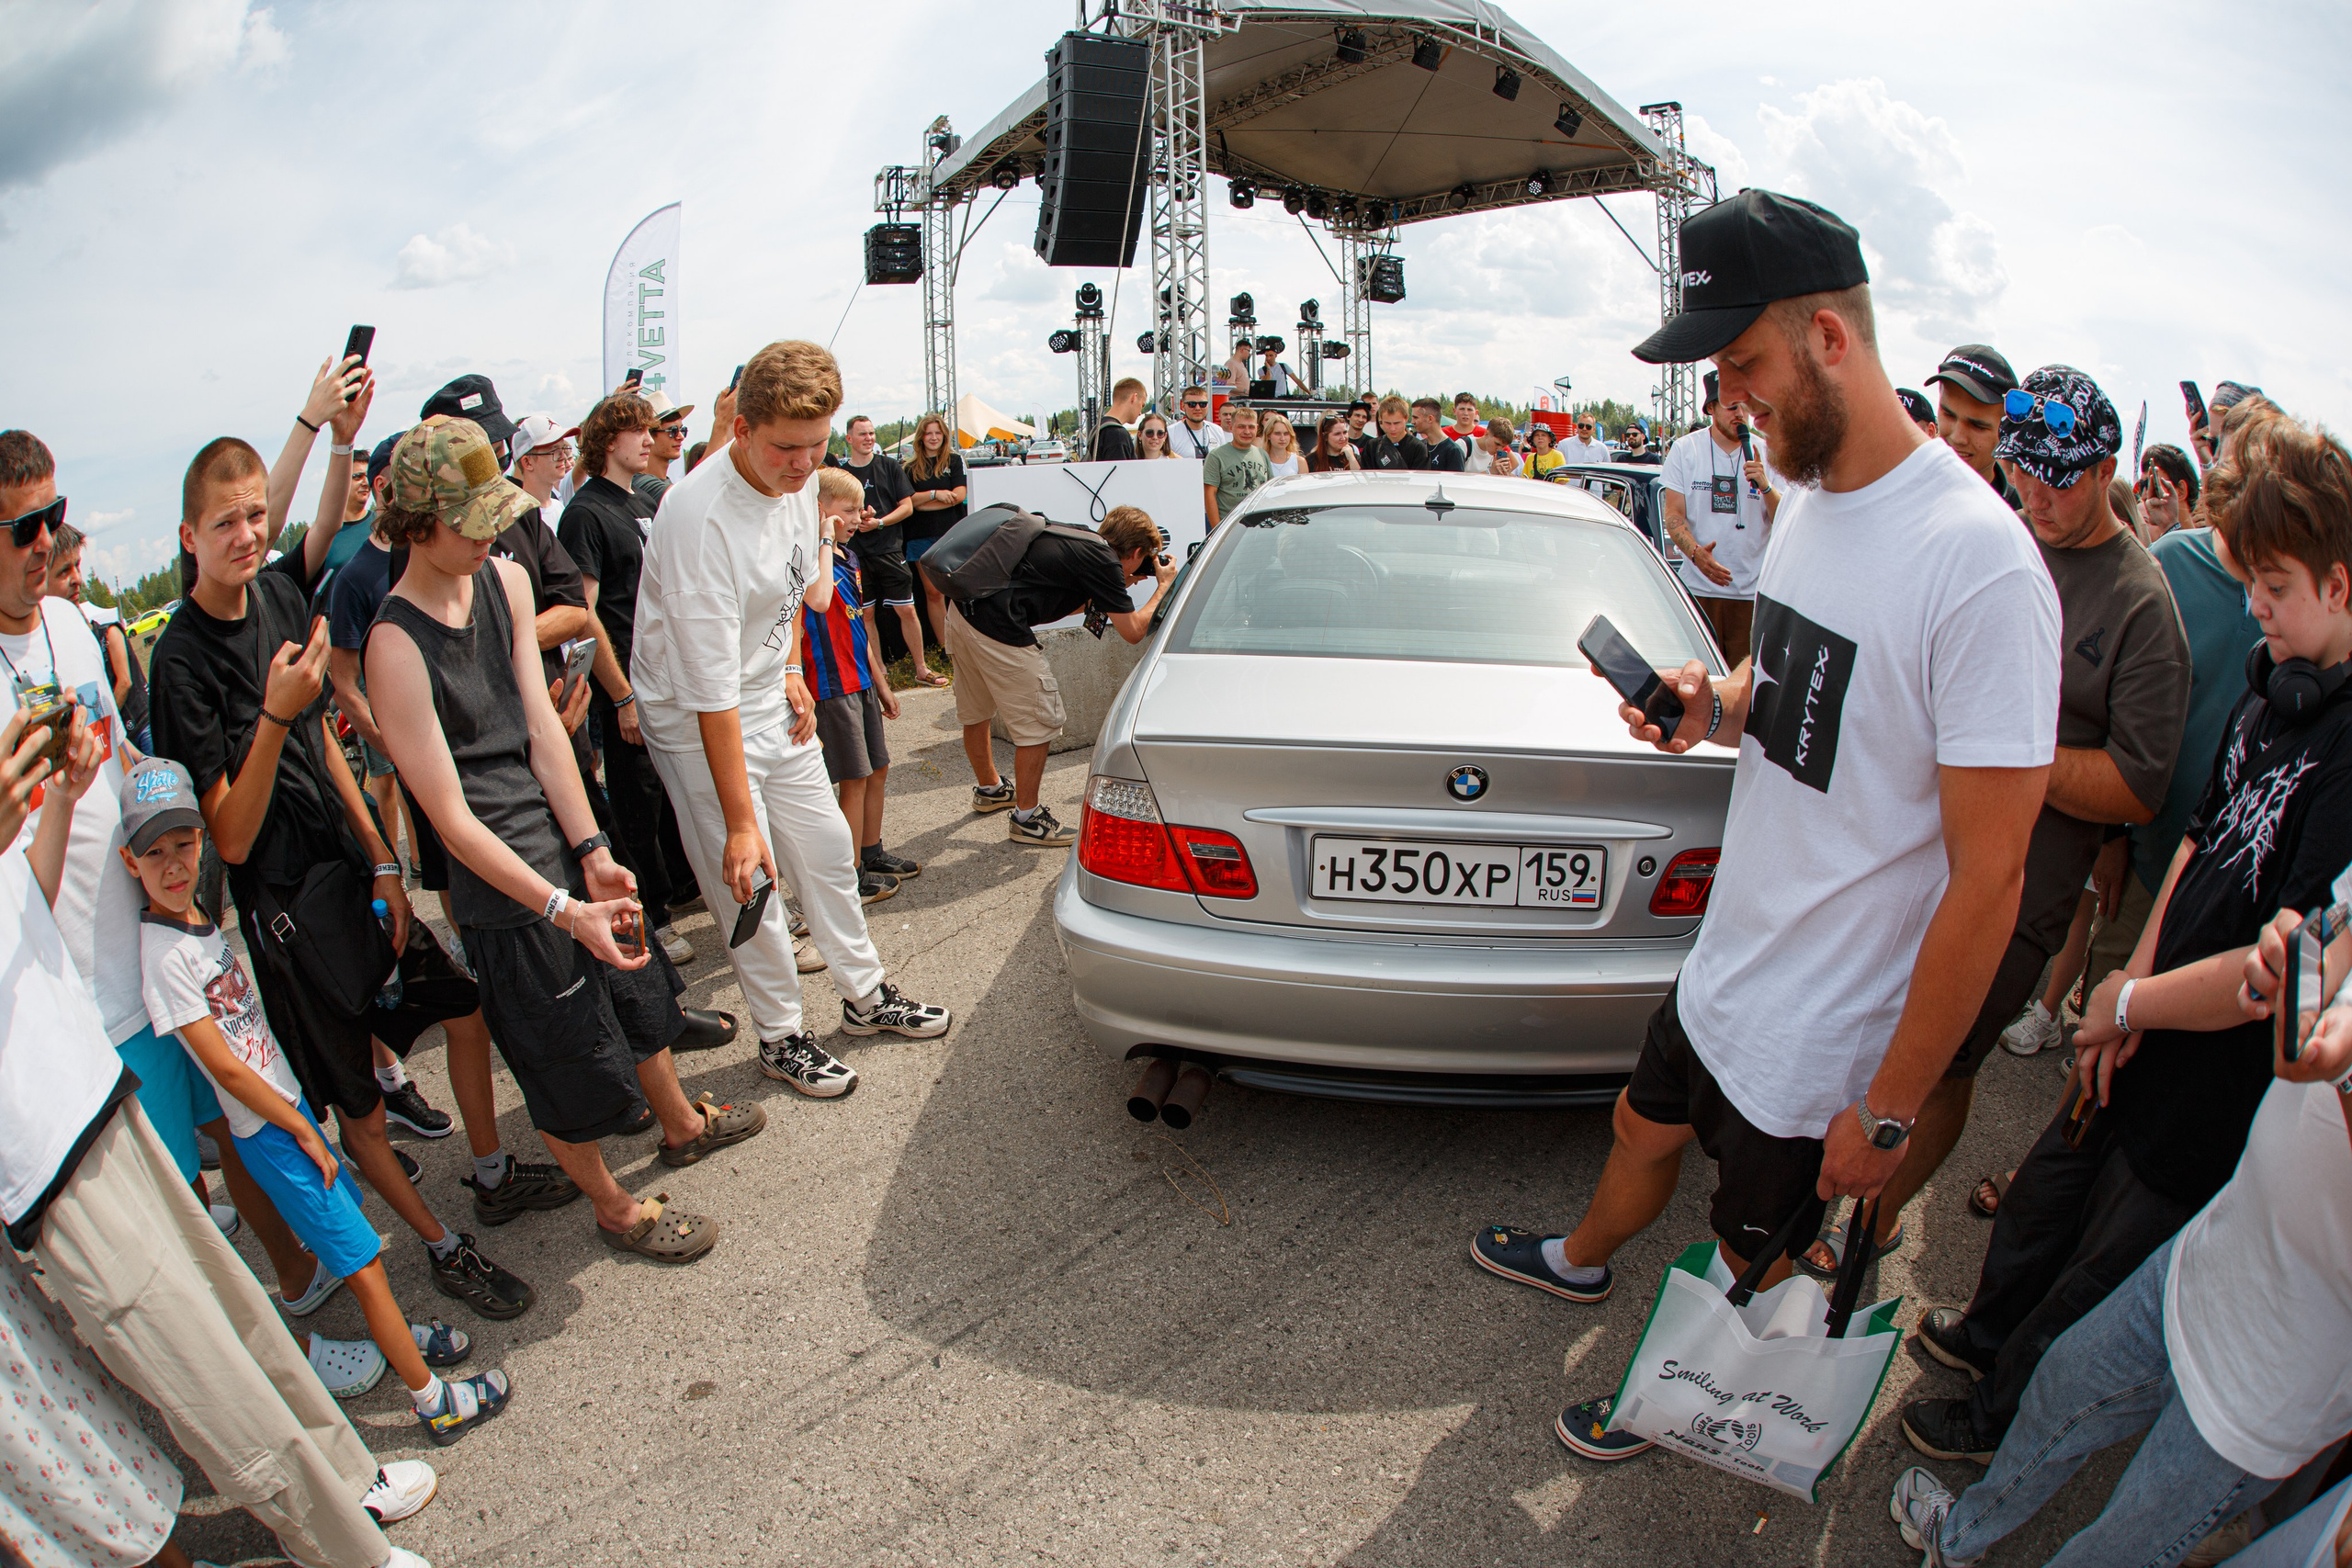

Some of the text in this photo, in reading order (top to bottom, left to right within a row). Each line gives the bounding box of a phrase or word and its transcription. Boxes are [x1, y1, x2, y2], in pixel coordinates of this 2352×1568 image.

[1682, 270, 1712, 288] TEX
[626, 261, 636, 367] елекомпания
[1945, 355, 1995, 378] Champion
[2046, 434, 2063, 446] STAY
[1227, 460, 1268, 478] VARSITY
[1795, 646, 1829, 767] KRYTEX
[1451, 767, 1487, 781] BMW
[1525, 852, 1590, 888] 159
[1538, 888, 1571, 901] RUS
[1658, 1359, 1829, 1434] Smiling at Work
[1663, 1429, 1722, 1456] Hans
[1736, 1423, 1757, 1450] Tools
